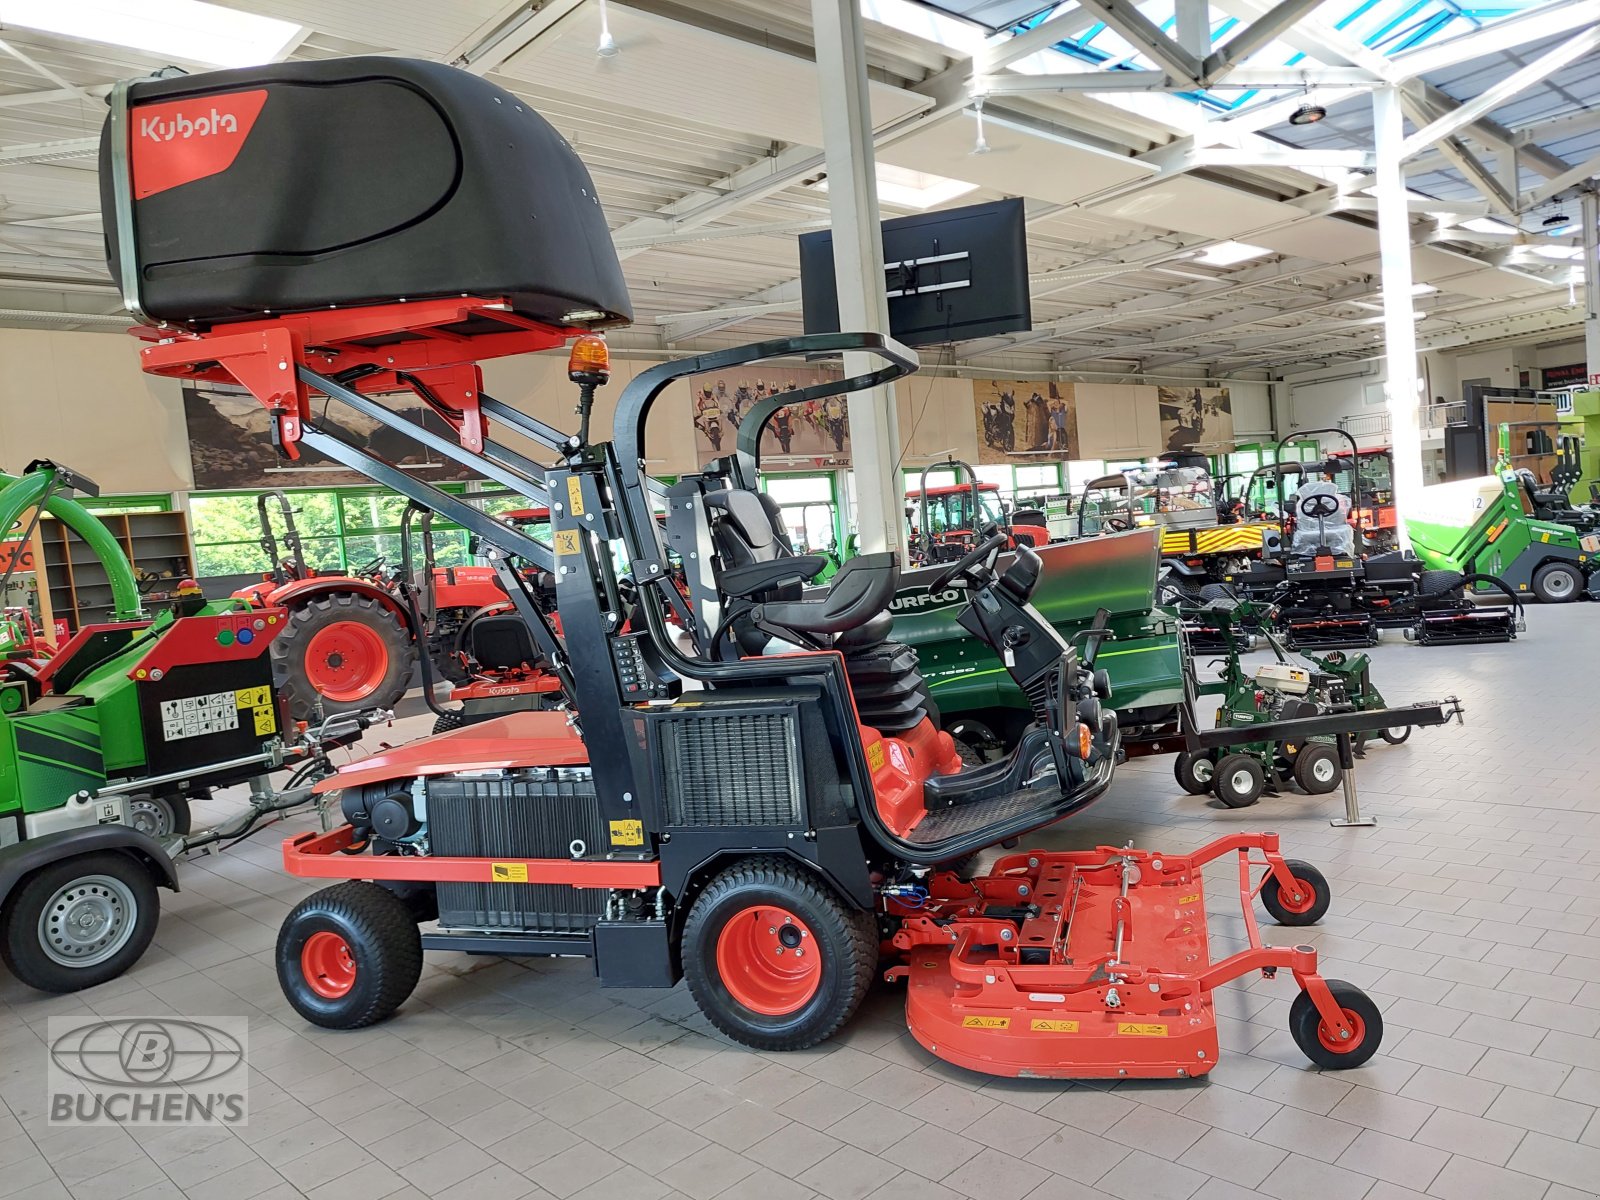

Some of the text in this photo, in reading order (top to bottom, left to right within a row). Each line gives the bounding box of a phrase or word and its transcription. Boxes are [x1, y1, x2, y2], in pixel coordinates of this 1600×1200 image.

[141, 108, 238, 142] Kubota
[888, 589, 959, 610] URFCO
[489, 687, 519, 695] Kubota
